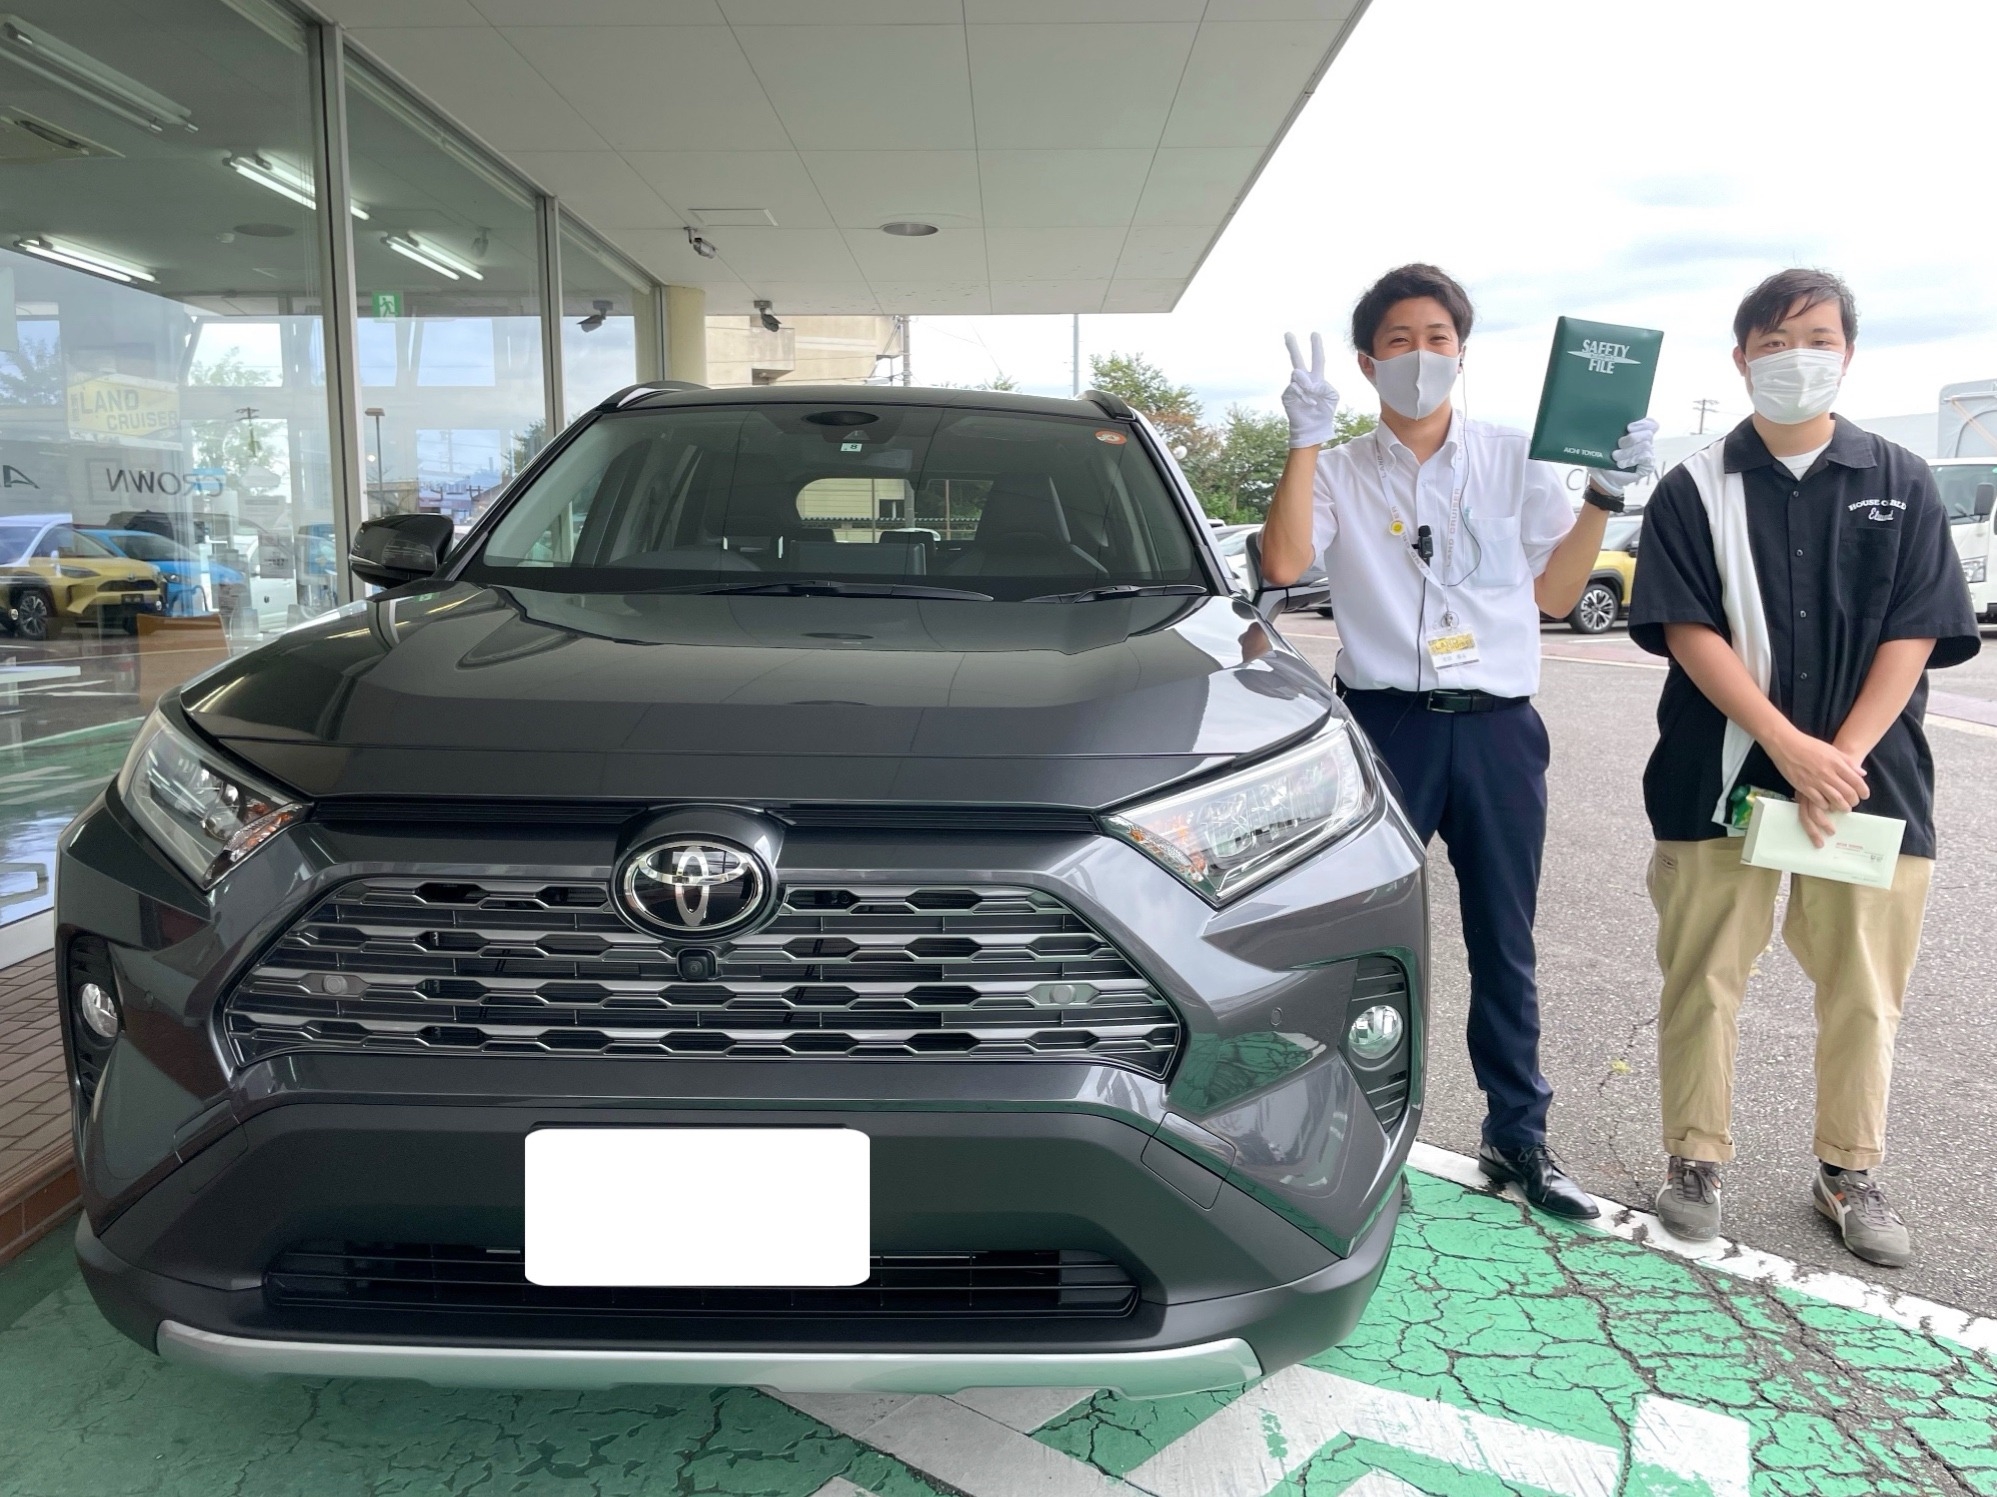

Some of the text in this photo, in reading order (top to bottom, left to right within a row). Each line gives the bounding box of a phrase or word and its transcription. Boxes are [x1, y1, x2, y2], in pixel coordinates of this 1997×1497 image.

[1581, 339, 1630, 358] SAFETY
[1588, 358, 1615, 375] FILE
[80, 389, 139, 414] LAND
[107, 411, 178, 431] CRUISER
[1563, 446, 1604, 458] AICHI TOYOTA
[1450, 488, 1460, 535] CRUISER
[1848, 499, 1879, 511] HOUSE
